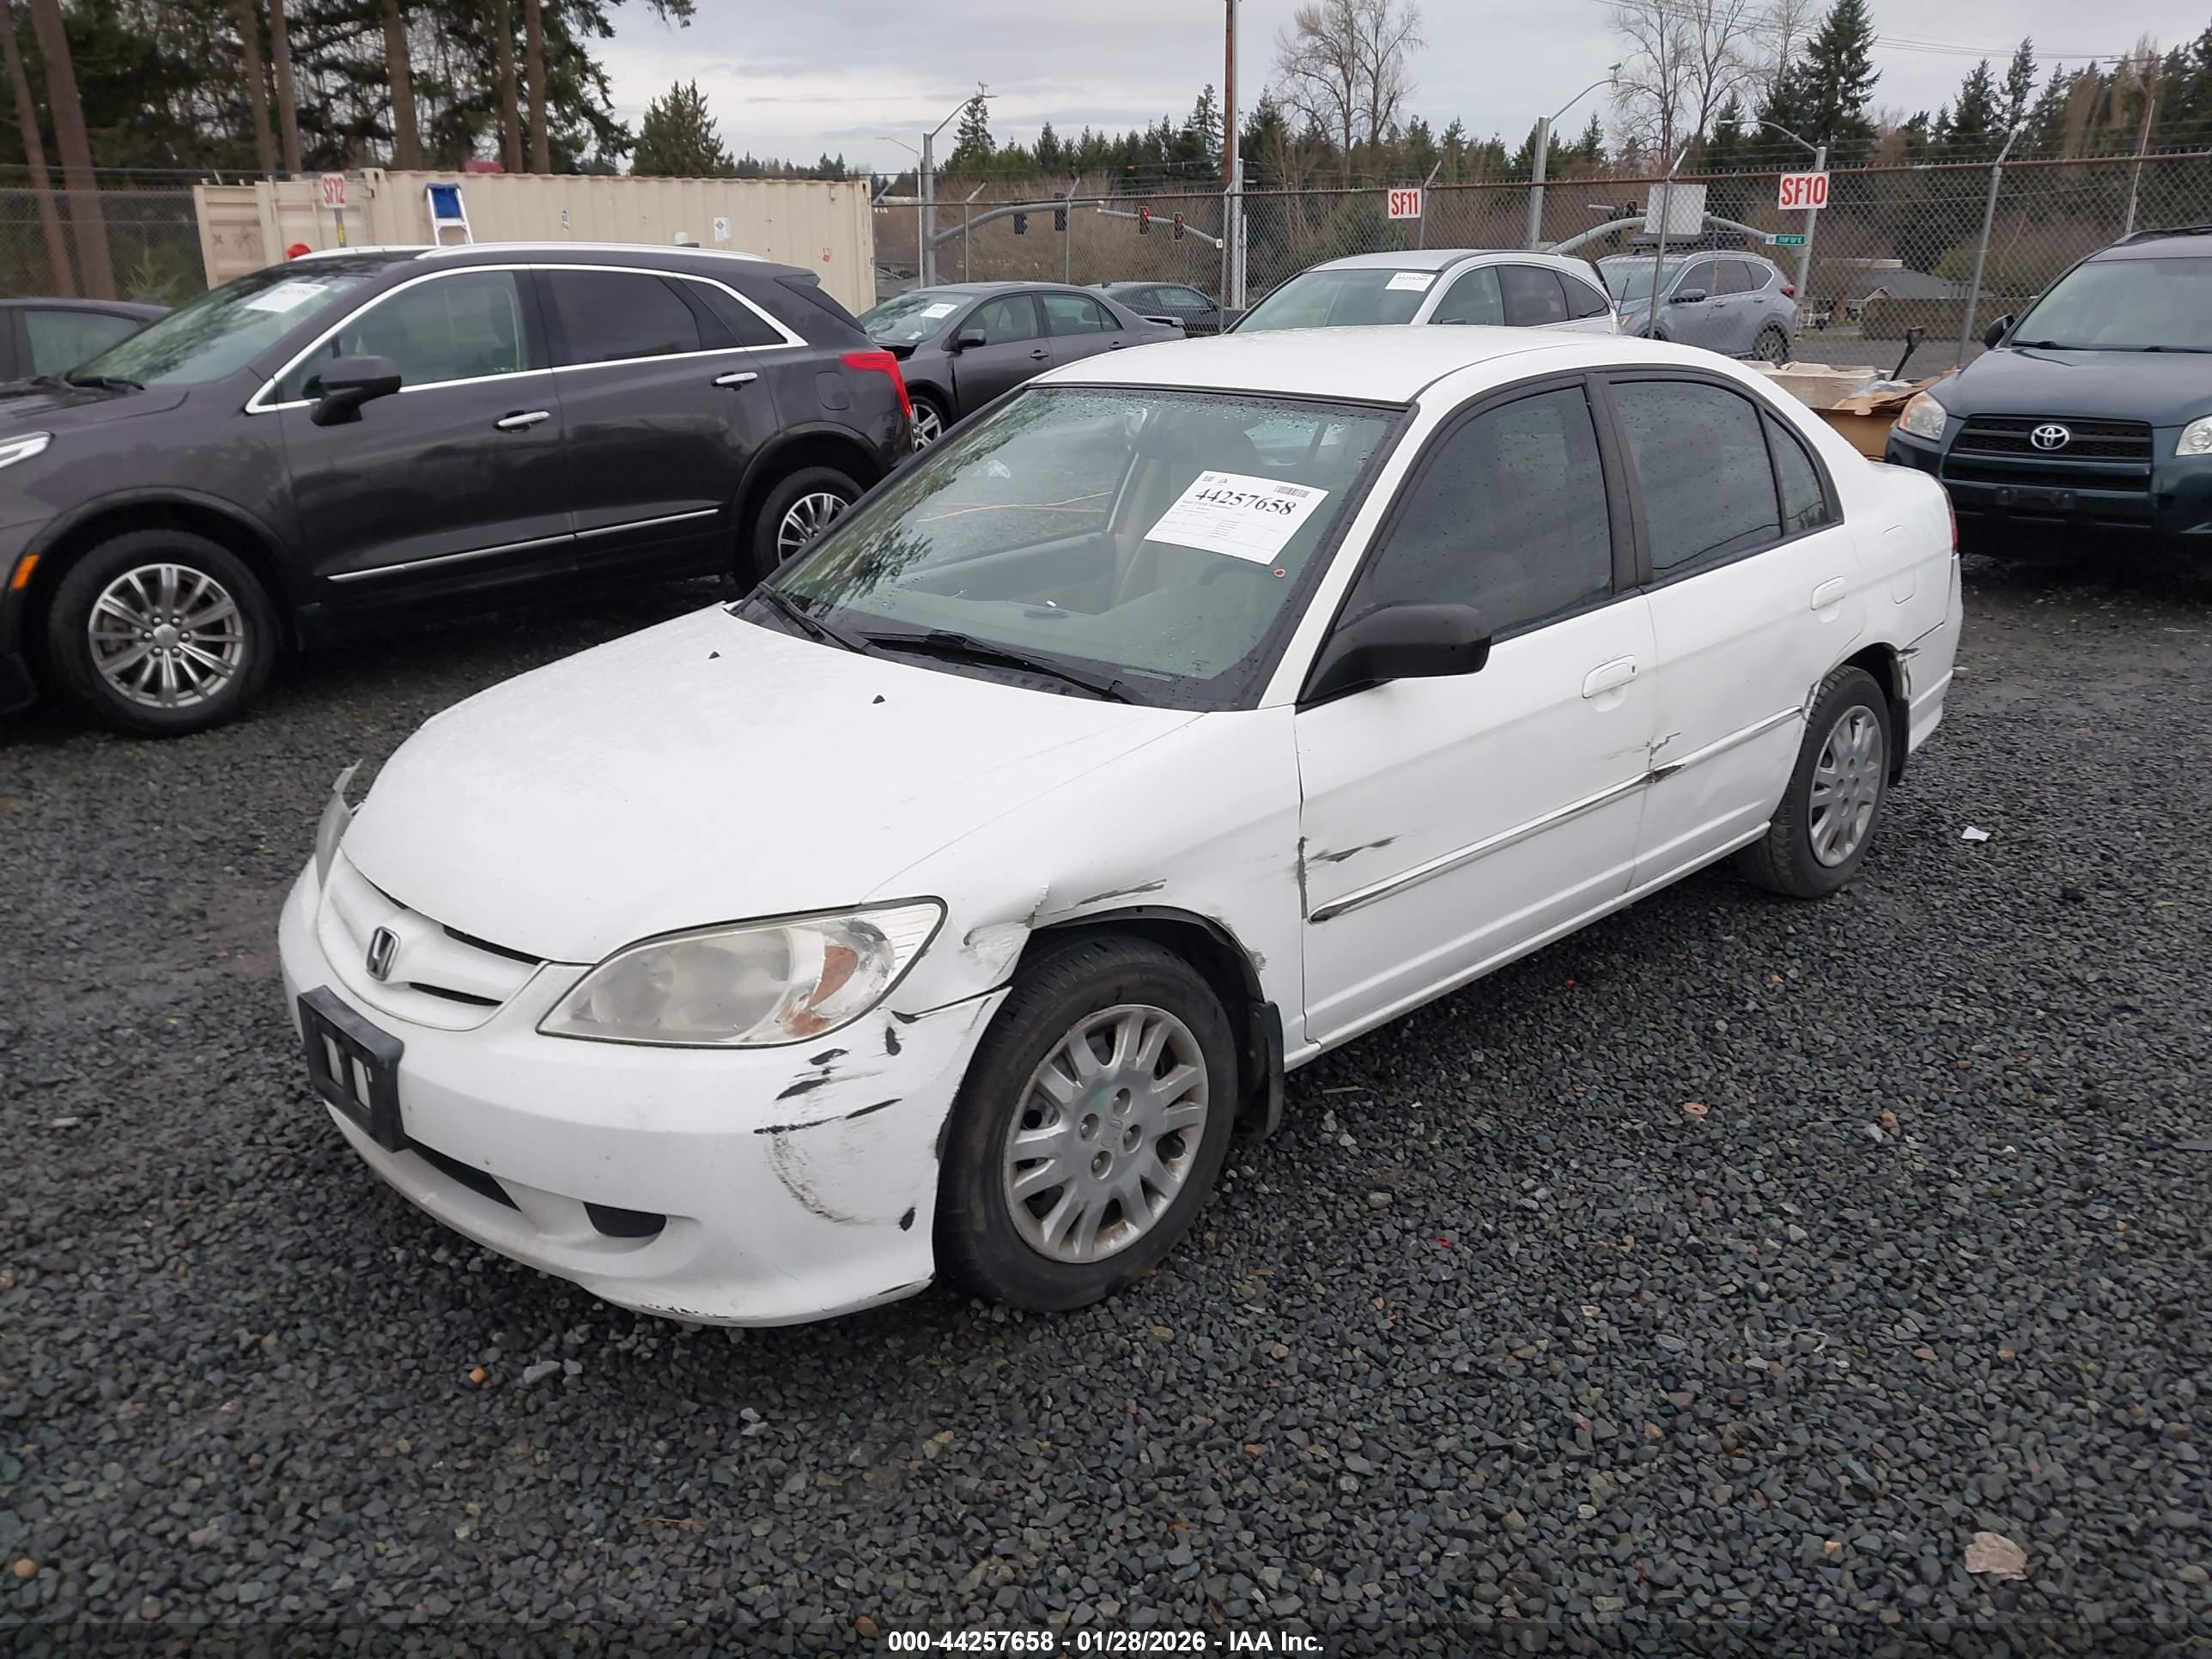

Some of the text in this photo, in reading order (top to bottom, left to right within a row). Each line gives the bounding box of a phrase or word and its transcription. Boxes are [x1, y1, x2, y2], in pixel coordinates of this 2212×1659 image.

[323, 177, 344, 204] SF12
[1391, 191, 1419, 216] SF11
[1781, 176, 1826, 206] SF10
[1194, 488, 1297, 515] 44257658
